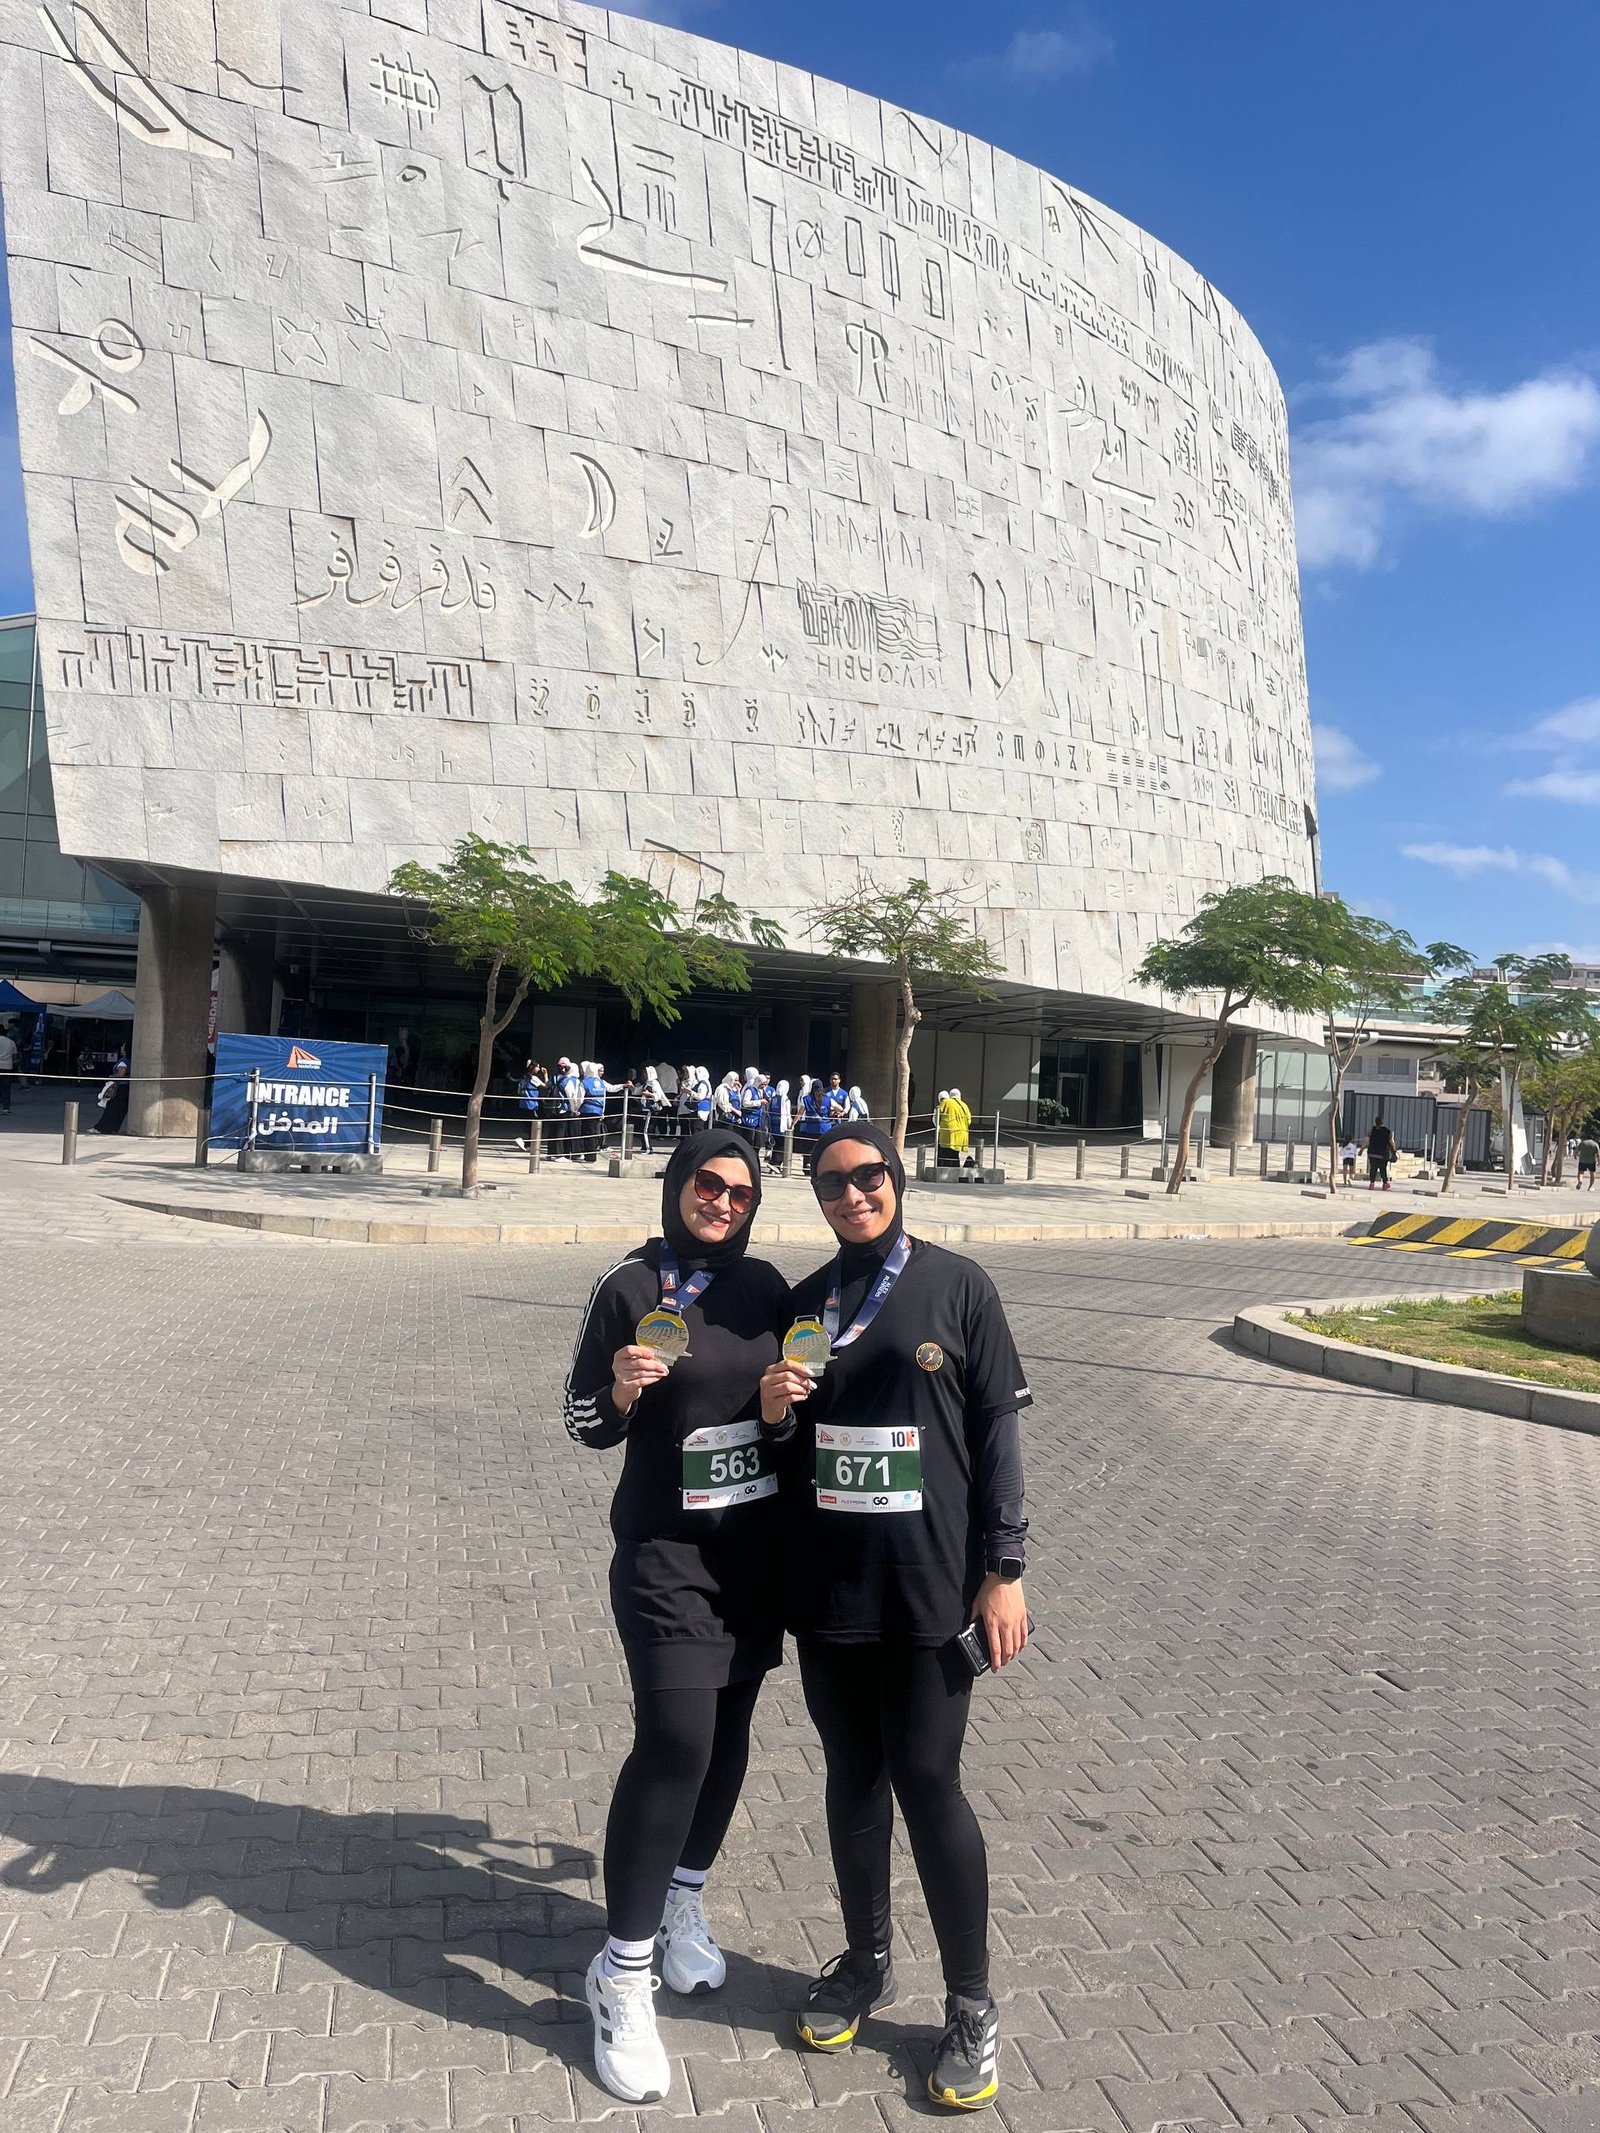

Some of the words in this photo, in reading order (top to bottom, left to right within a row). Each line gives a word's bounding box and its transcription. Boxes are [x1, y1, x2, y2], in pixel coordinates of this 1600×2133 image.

[257, 1111, 339, 1136] المدخل
[891, 1431, 915, 1447] 10K
[710, 1446, 760, 1483] 563
[835, 1455, 890, 1487] 671
[744, 1484, 757, 1495] GO
[873, 1496, 889, 1505] GO
